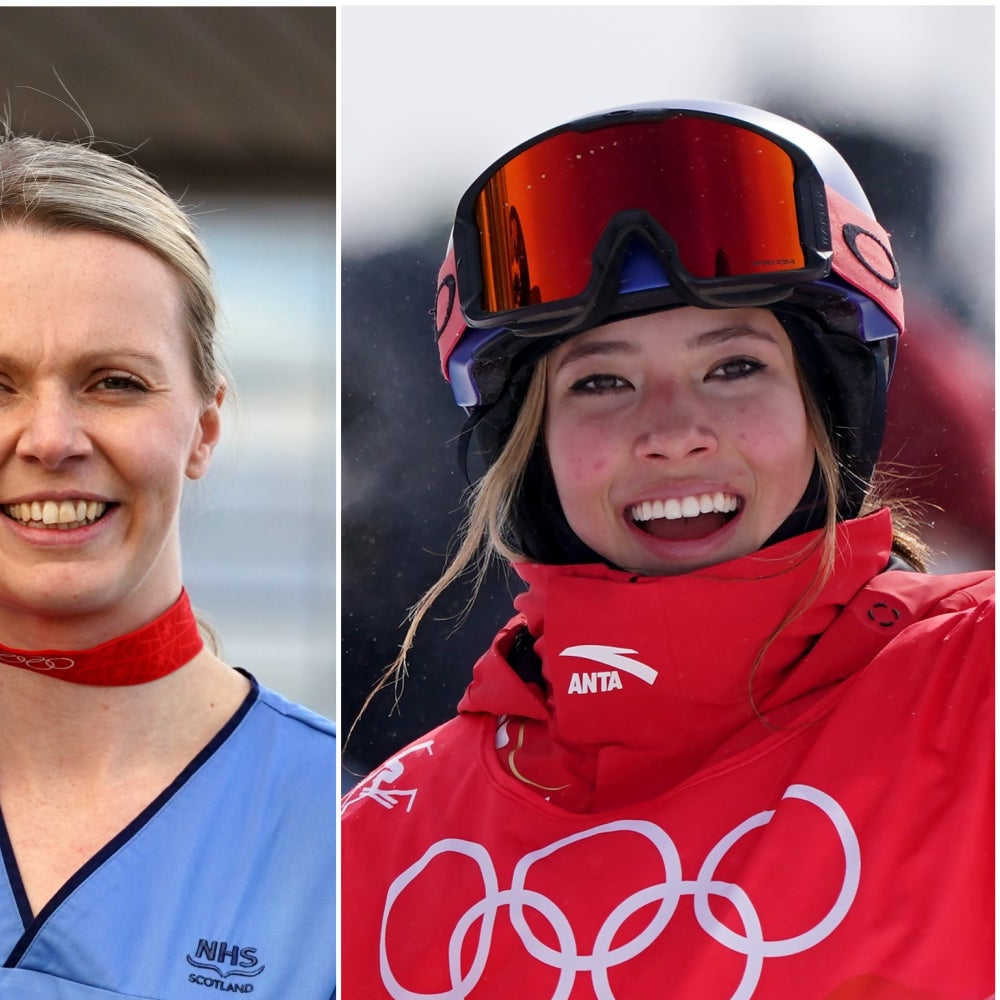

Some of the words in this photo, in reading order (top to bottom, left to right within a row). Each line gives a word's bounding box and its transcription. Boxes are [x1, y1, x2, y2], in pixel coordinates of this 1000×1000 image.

[567, 670, 623, 695] ANTA
[195, 938, 258, 968] NHS
[187, 973, 255, 994] SCOTLAND
